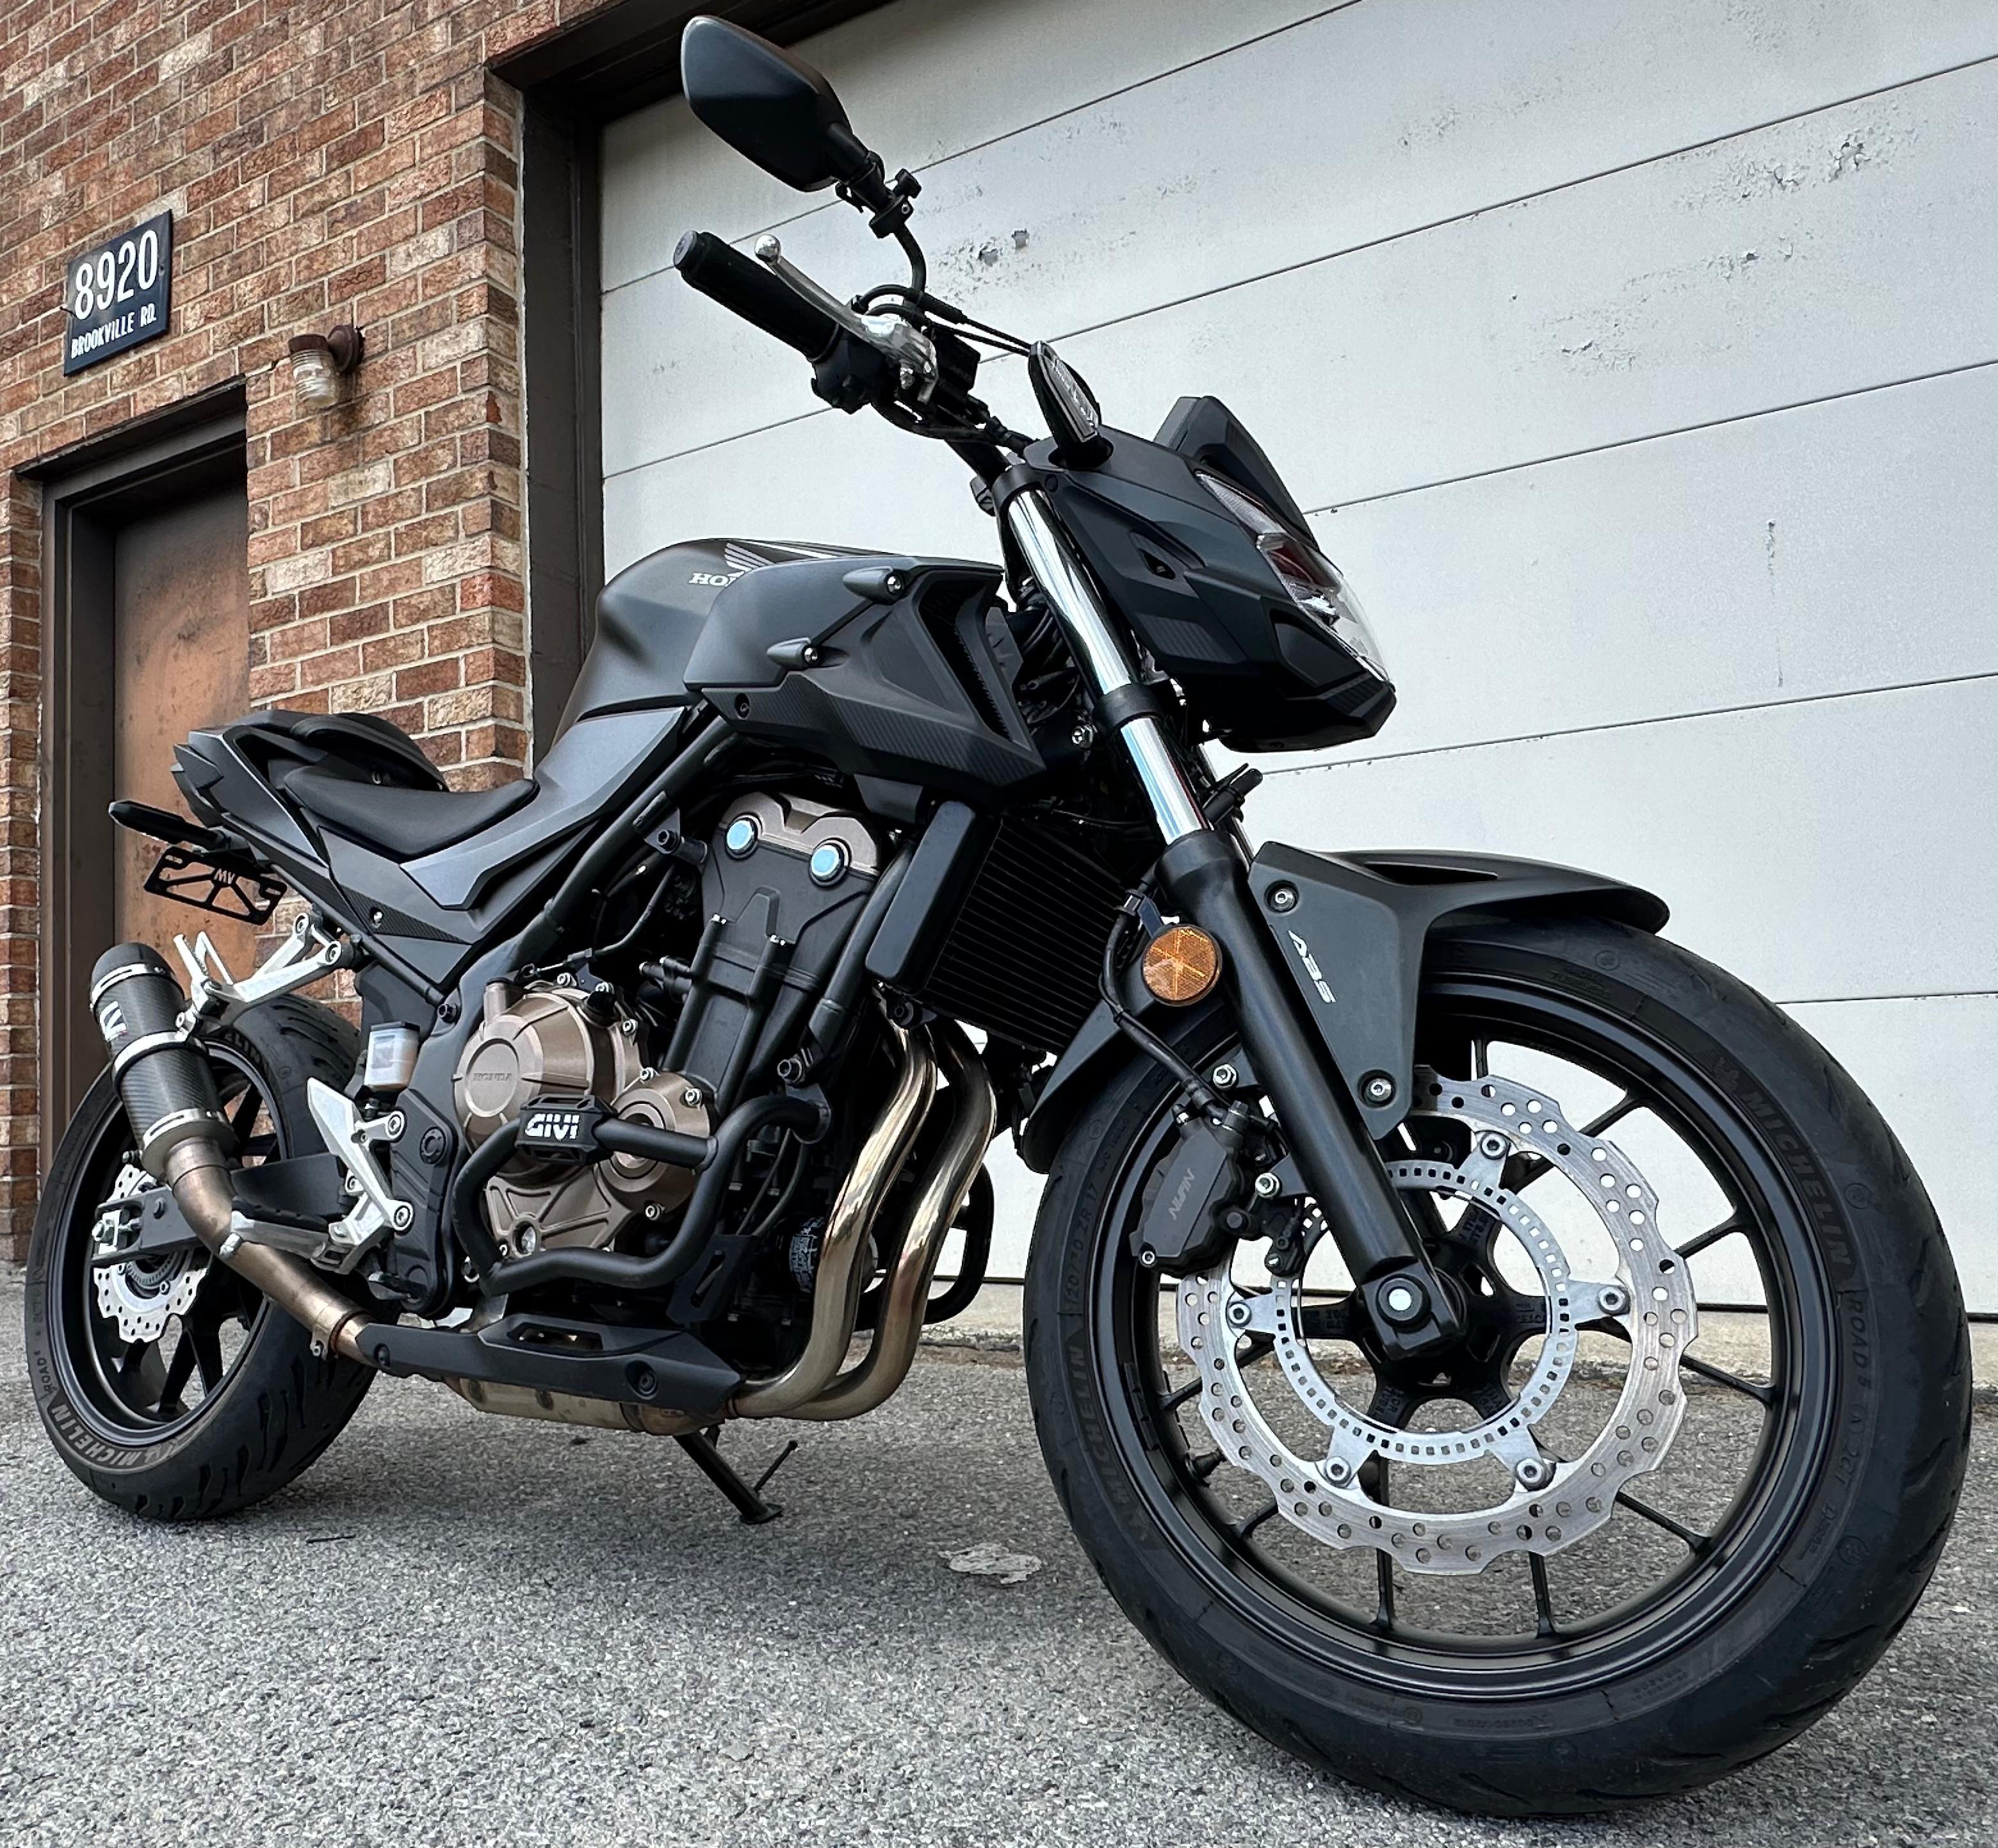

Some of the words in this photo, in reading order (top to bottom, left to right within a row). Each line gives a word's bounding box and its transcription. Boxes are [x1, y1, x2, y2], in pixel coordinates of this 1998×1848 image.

[75, 229, 158, 320] 8920
[70, 312, 135, 359] BROOKVILLE
[1288, 930, 1336, 1003] ABS
[473, 1073, 513, 1082] HONDA
[524, 1113, 580, 1141] GIVI
[1741, 1090, 1853, 1265] MICHELIN
[1848, 1299, 1870, 1369] ROAD
[37, 1356, 54, 1393] ROAD
[51, 1404, 142, 1466] MICHELIN
[1066, 1346, 1130, 1504] MICHELIN
